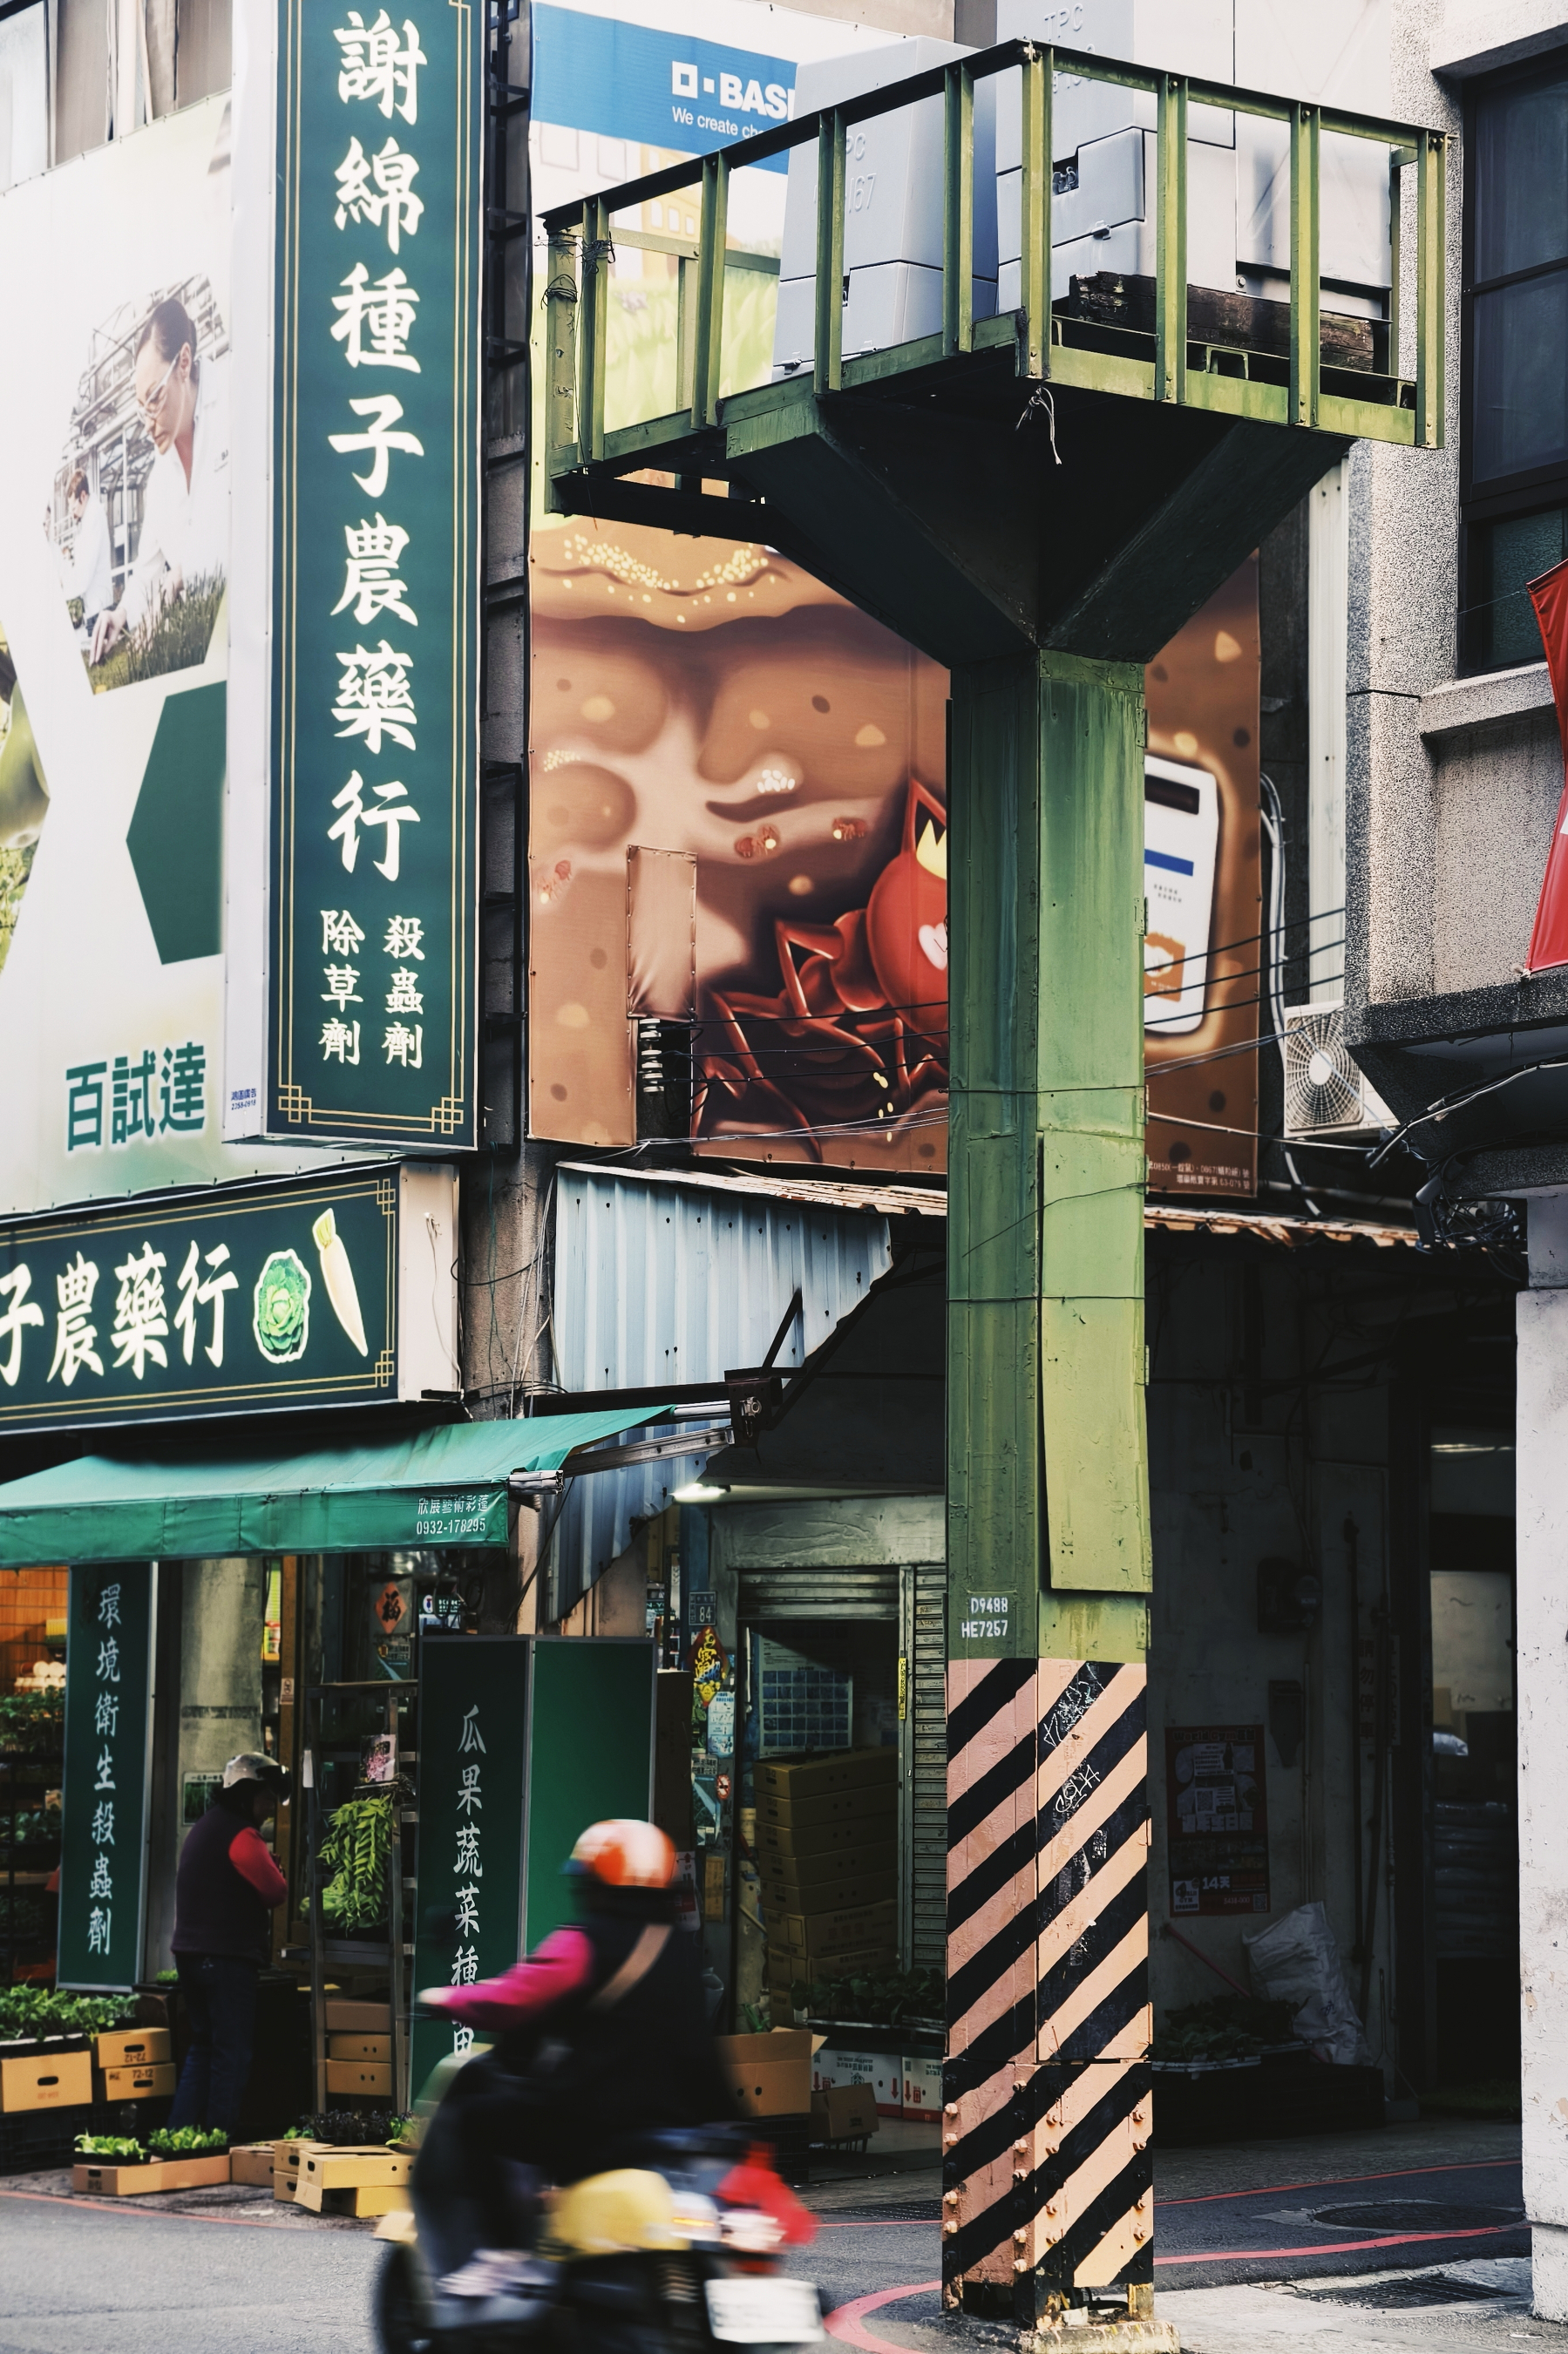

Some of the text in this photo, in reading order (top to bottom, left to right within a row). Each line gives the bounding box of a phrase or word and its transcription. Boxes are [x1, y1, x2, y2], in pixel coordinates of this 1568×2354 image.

[672, 105, 767, 139] We create ch
[328, 9, 428, 882] 謝綿種子農藥行
[319, 910, 365, 1065] 除草劑
[382, 915, 425, 1068] 殺蟲劑
[65, 1041, 206, 1151] 百試達
[0, 1241, 239, 1387] 子農藥行
[417, 1517, 486, 1535] 0932-178295
[381, 1591, 401, 1623] 福
[699, 1606, 713, 1623] 84
[961, 1620, 1008, 1638] HE7257
[970, 1597, 1008, 1614] D9488
[1356, 1639, 1375, 1740] 請勿停車
[88, 1583, 122, 1957] 環境衛生殺蟲劑
